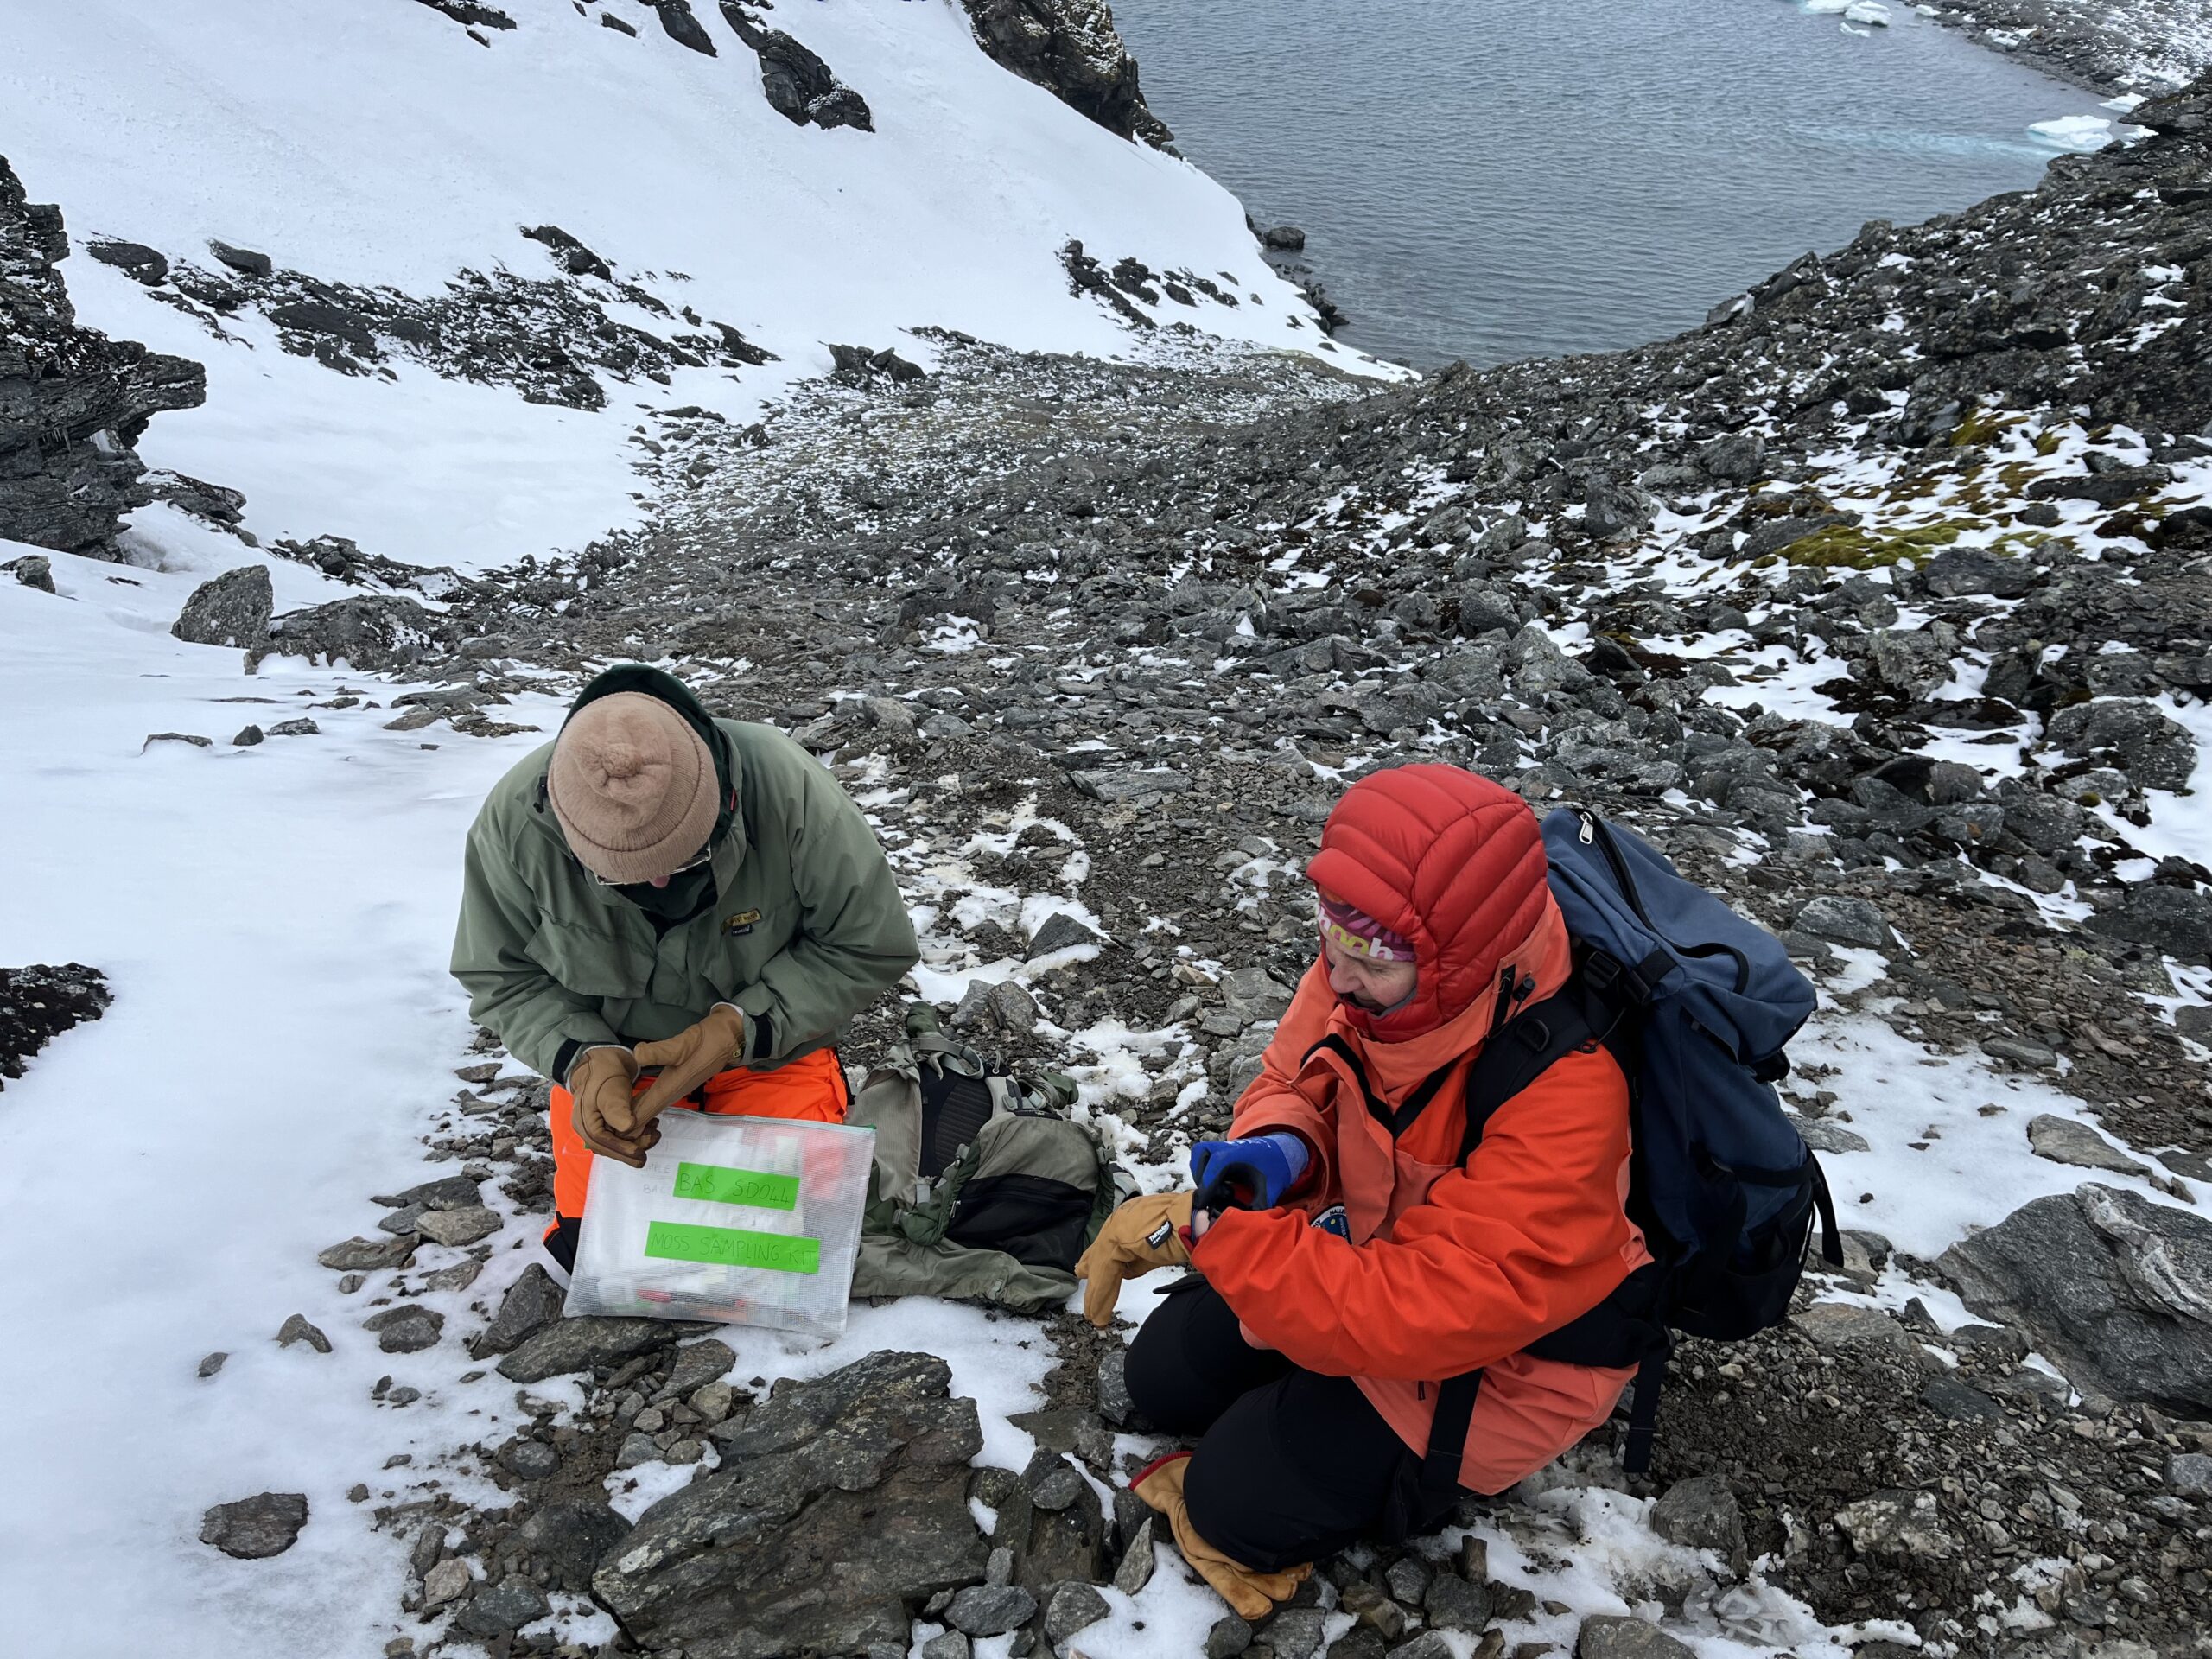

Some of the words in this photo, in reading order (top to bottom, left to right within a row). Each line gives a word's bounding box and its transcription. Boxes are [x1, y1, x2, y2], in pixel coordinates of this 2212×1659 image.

[679, 1173, 715, 1193] BAS
[652, 1232, 690, 1251] MOSS
[700, 1236, 780, 1261] SAMPLING
[790, 1248, 818, 1266] KIT
